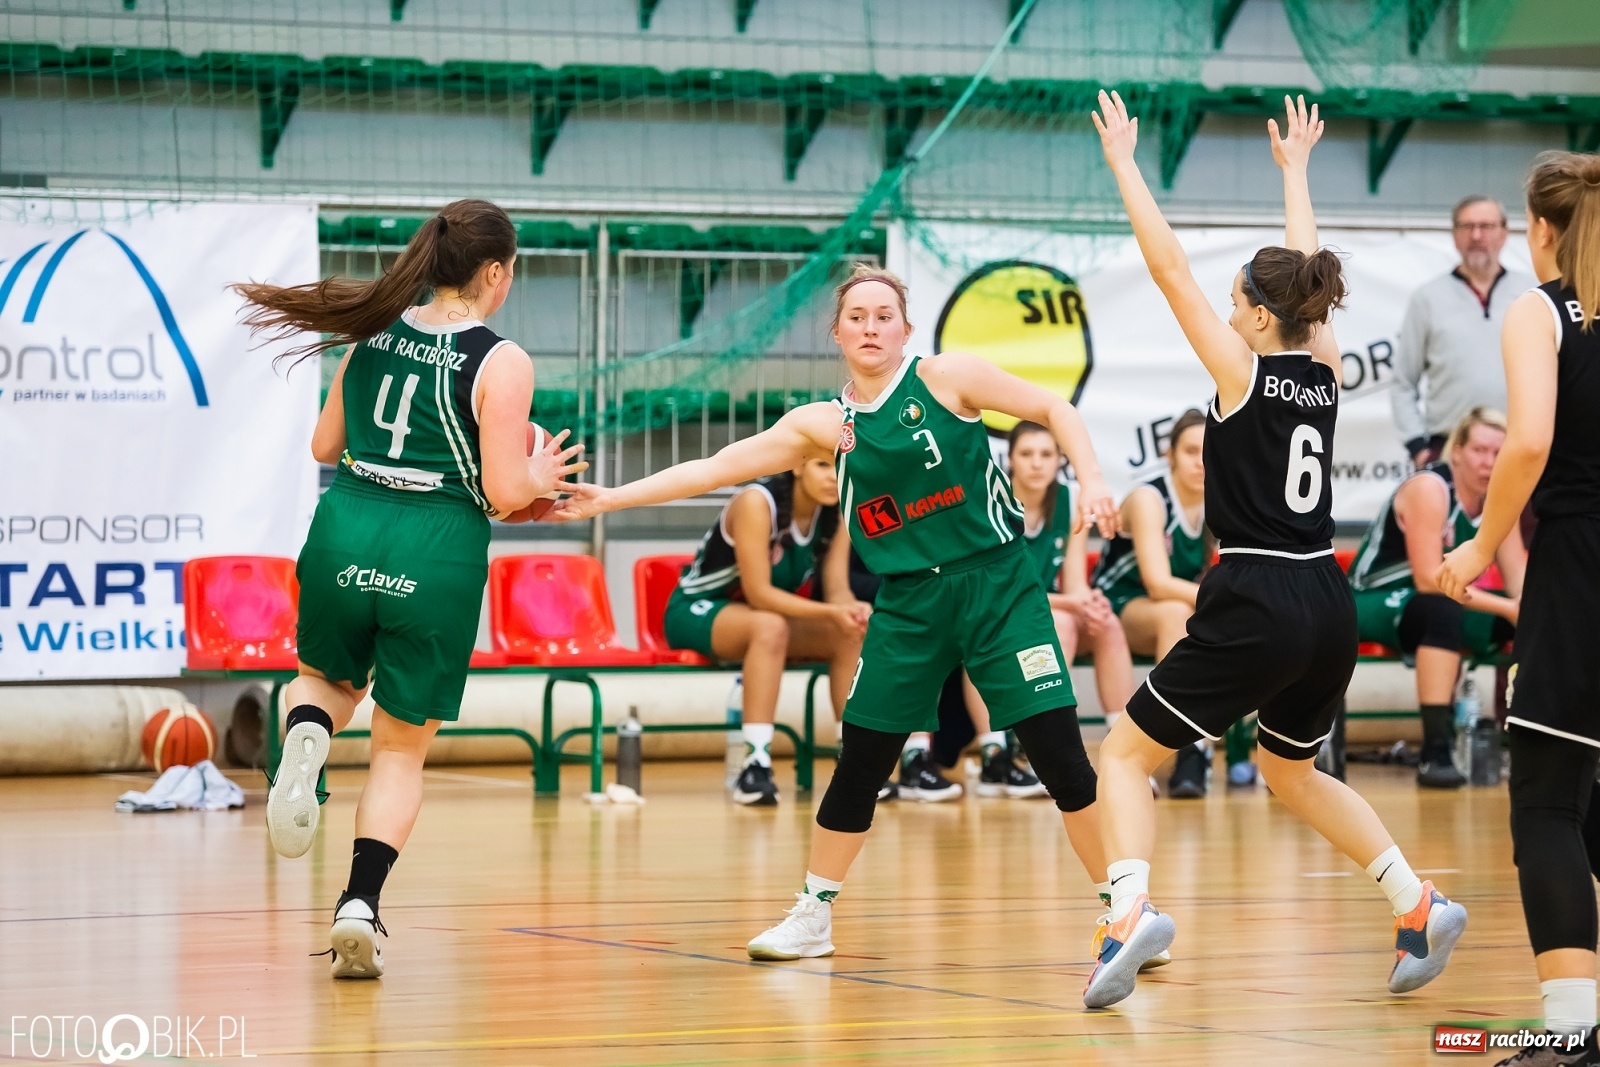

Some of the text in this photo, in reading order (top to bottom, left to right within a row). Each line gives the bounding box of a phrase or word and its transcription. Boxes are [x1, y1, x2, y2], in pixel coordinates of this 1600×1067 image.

[367, 332, 469, 371] RKK RACIBÓRZ
[13, 388, 167, 402] partner w badaniach
[373, 373, 420, 460] 4
[912, 429, 943, 470] 3
[1284, 424, 1324, 513] 6
[0, 514, 204, 543] PONSOR
[859, 499, 900, 534] K
[356, 568, 418, 593] Clavis
